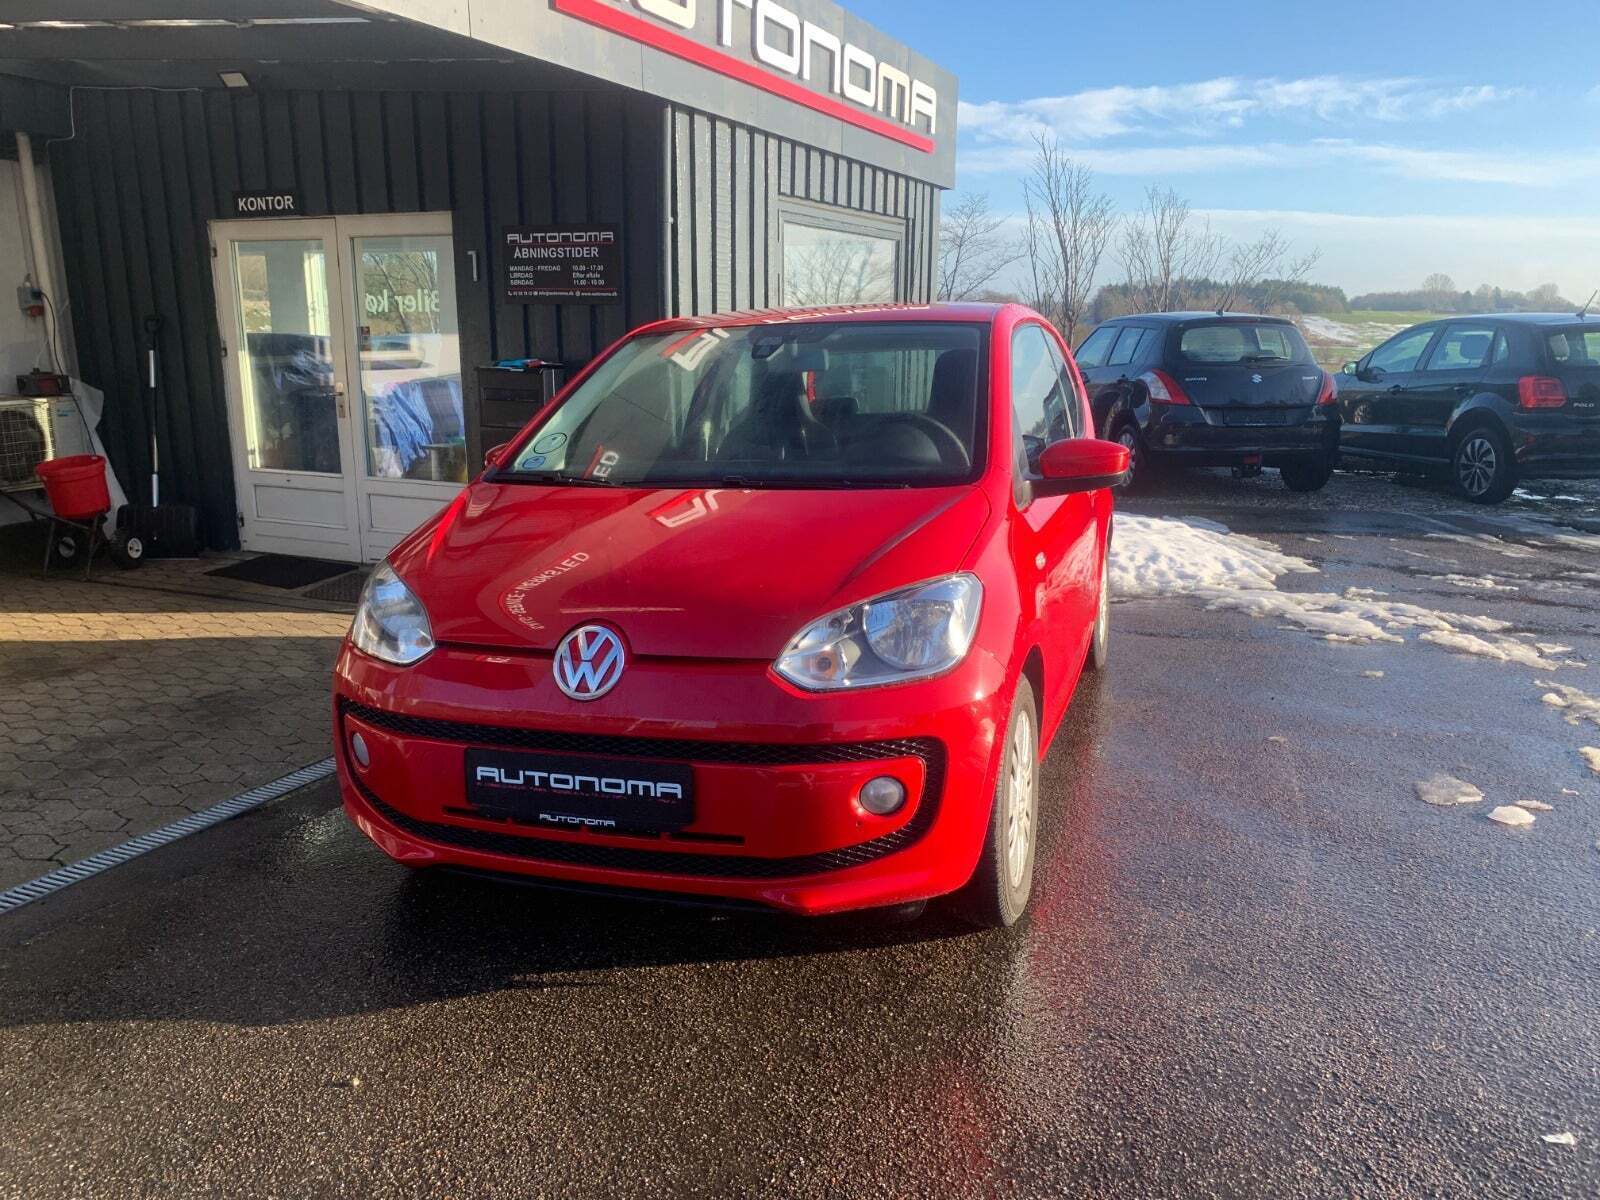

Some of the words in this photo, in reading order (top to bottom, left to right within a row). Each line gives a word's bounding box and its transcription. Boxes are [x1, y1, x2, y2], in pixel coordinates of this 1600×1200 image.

[630, 0, 937, 134] TONOMA
[237, 195, 294, 212] KONTOR
[506, 231, 614, 244] AUTONOMA
[513, 246, 599, 259] ÅBNINGSTIDER
[476, 766, 682, 799] AUTONOMA
[539, 813, 616, 827] AUTONOMA
